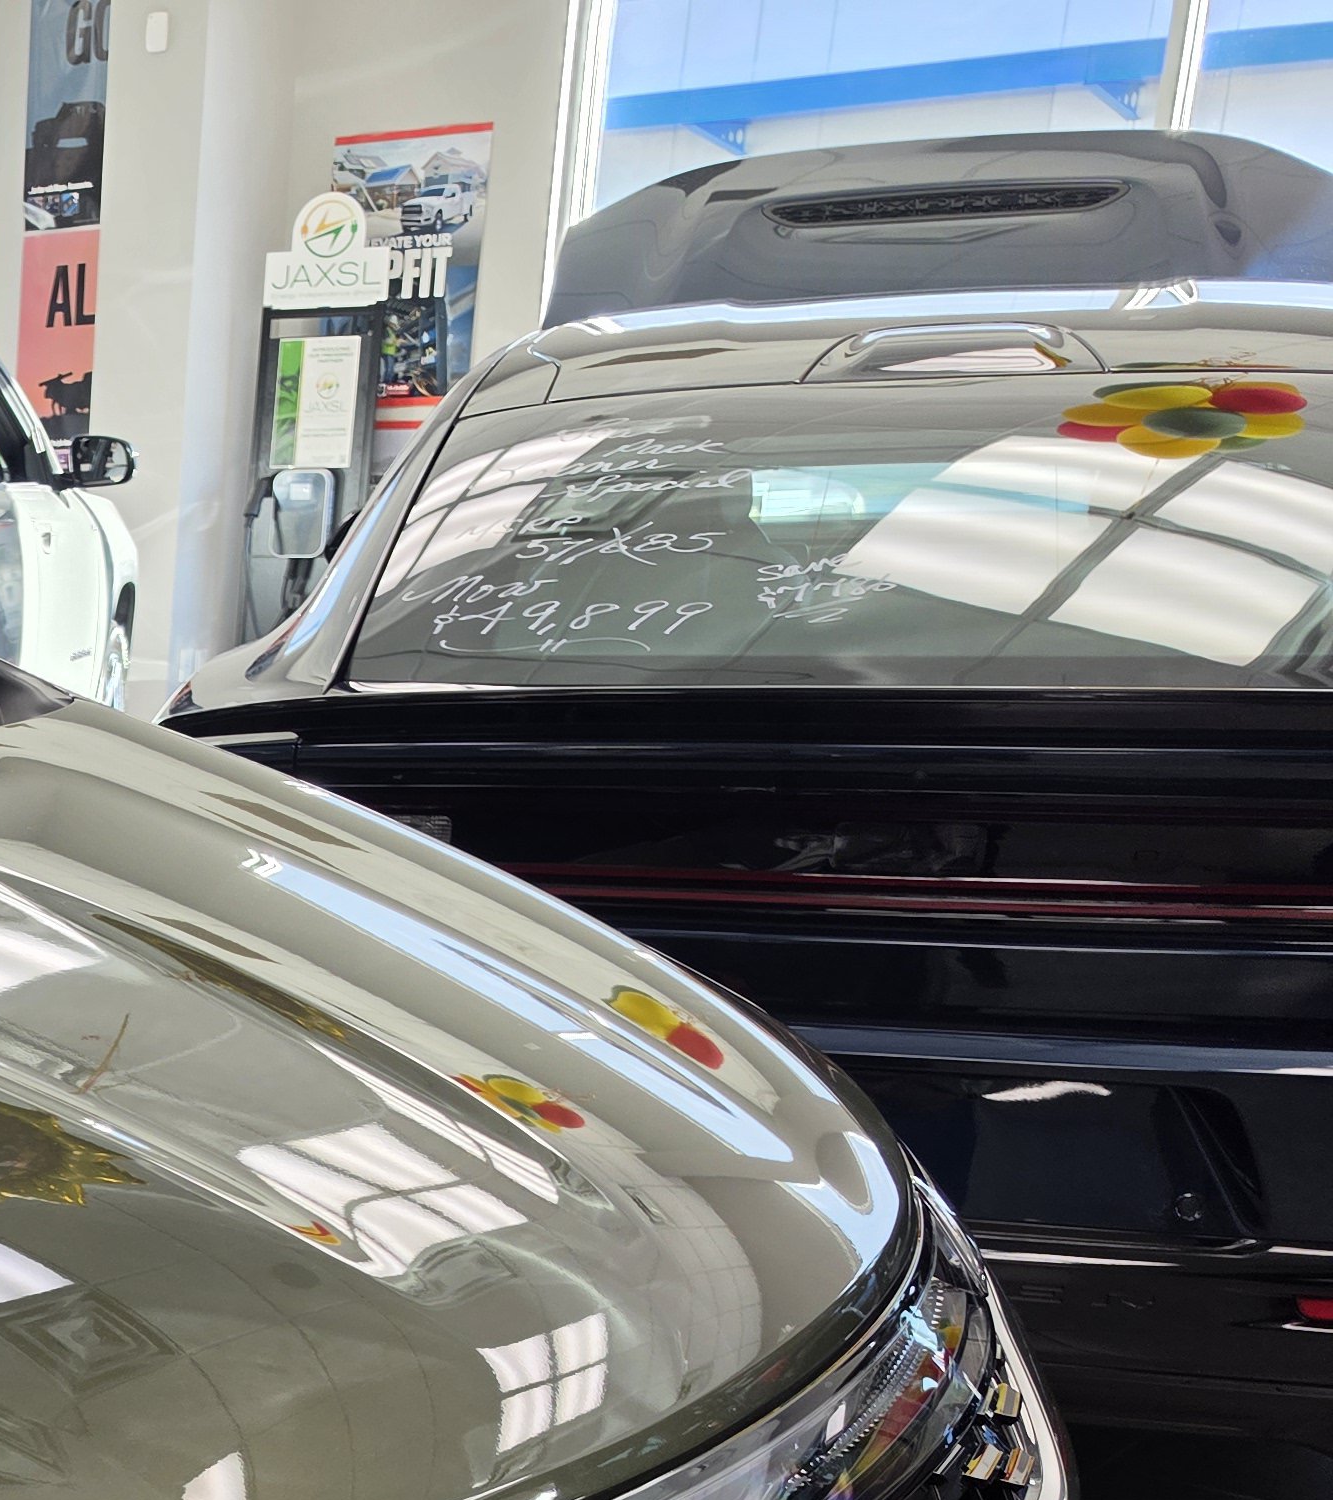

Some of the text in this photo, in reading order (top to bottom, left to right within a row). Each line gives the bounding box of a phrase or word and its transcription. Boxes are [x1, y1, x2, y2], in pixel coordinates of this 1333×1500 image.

[415, 232, 453, 248] YOUR
[271, 261, 381, 290] JAXSL
[388, 246, 453, 299] PFIT
